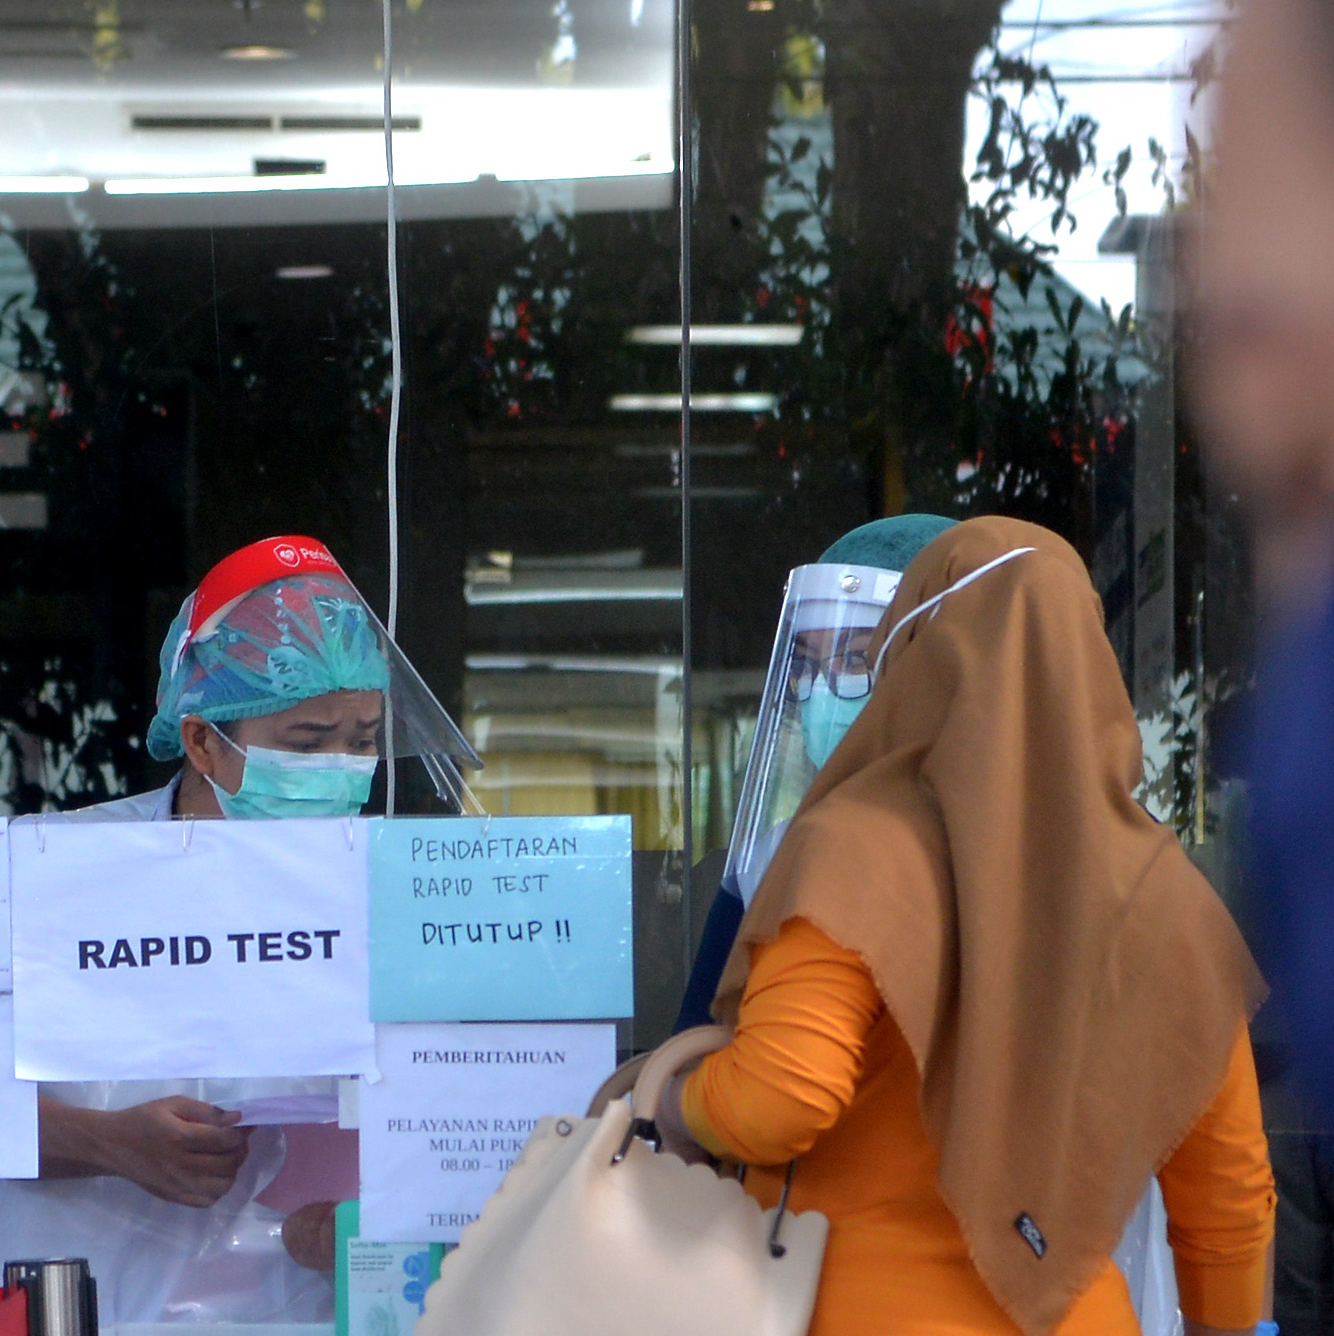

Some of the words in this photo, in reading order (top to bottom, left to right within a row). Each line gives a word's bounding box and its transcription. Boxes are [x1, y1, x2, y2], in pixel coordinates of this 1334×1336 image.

[411, 836, 578, 861] PENDAFTARAN
[412, 876, 473, 899] RAPID
[492, 874, 549, 896] TEST
[421, 920, 543, 946] DITUTUP
[78, 935, 212, 970] RAPID
[227, 930, 340, 963] TEST
[411, 1050, 566, 1064] PEMBERITAHUAN
[387, 1119, 488, 1132] PELAYANAN
[429, 1139, 485, 1151] MULAI
[490, 1139, 524, 1151] PUK
[440, 1159, 480, 1171] 08.00
[428, 1214, 480, 1226] TERIM
